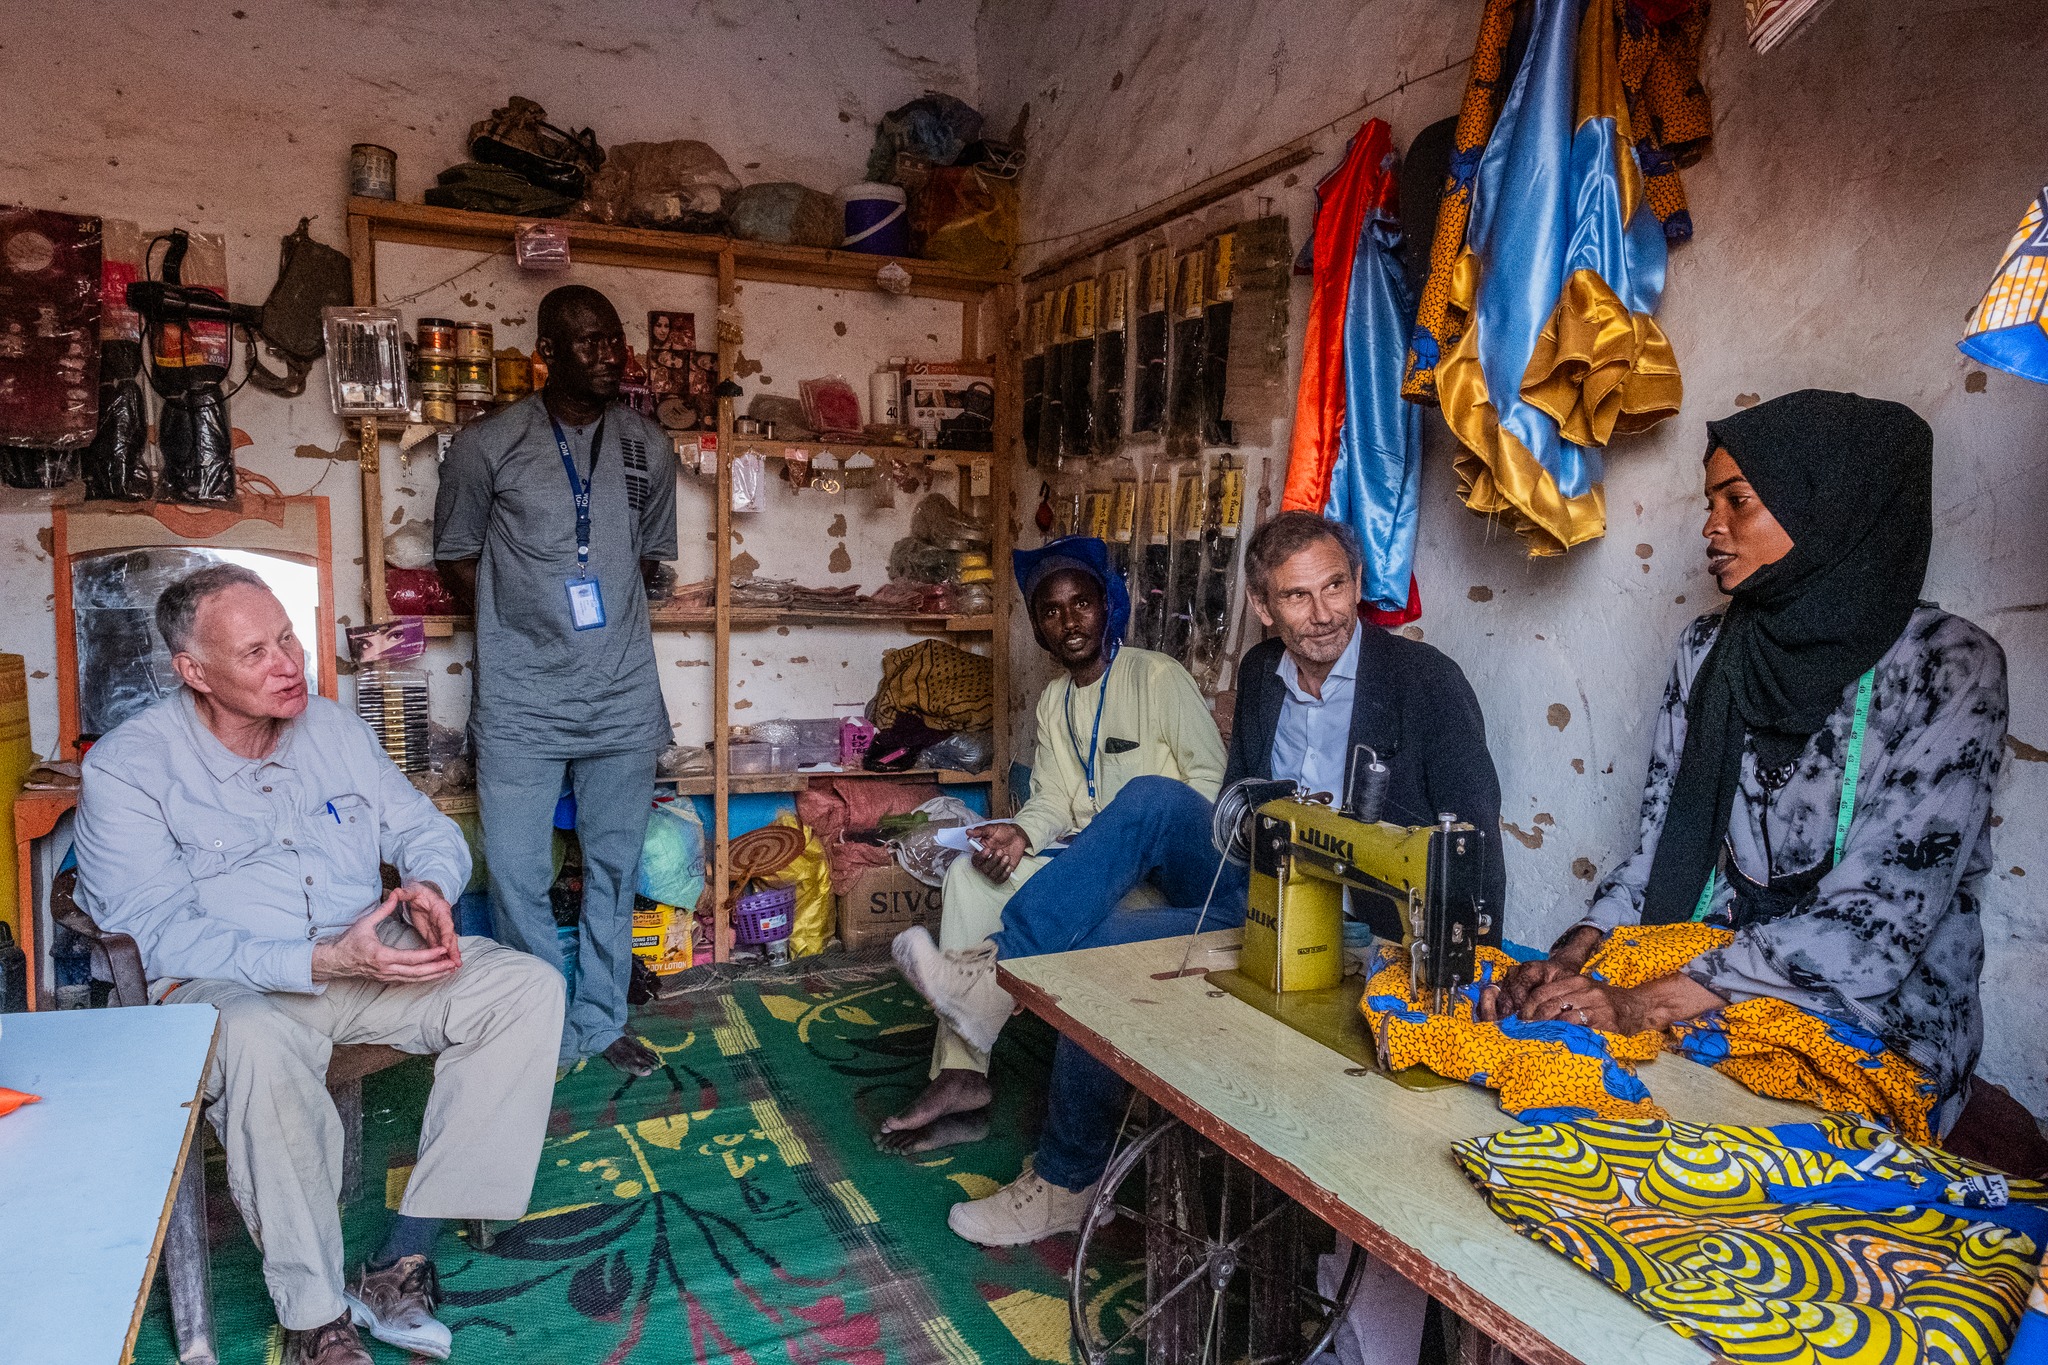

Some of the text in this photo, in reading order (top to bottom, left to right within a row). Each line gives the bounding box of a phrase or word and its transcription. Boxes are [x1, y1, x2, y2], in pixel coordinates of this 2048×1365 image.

[886, 406, 898, 419] 40
[559, 441, 570, 456] IOM
[581, 493, 589, 507] IOM
[1299, 827, 1354, 861] JUKI
[664, 961, 687, 970] LOTION
